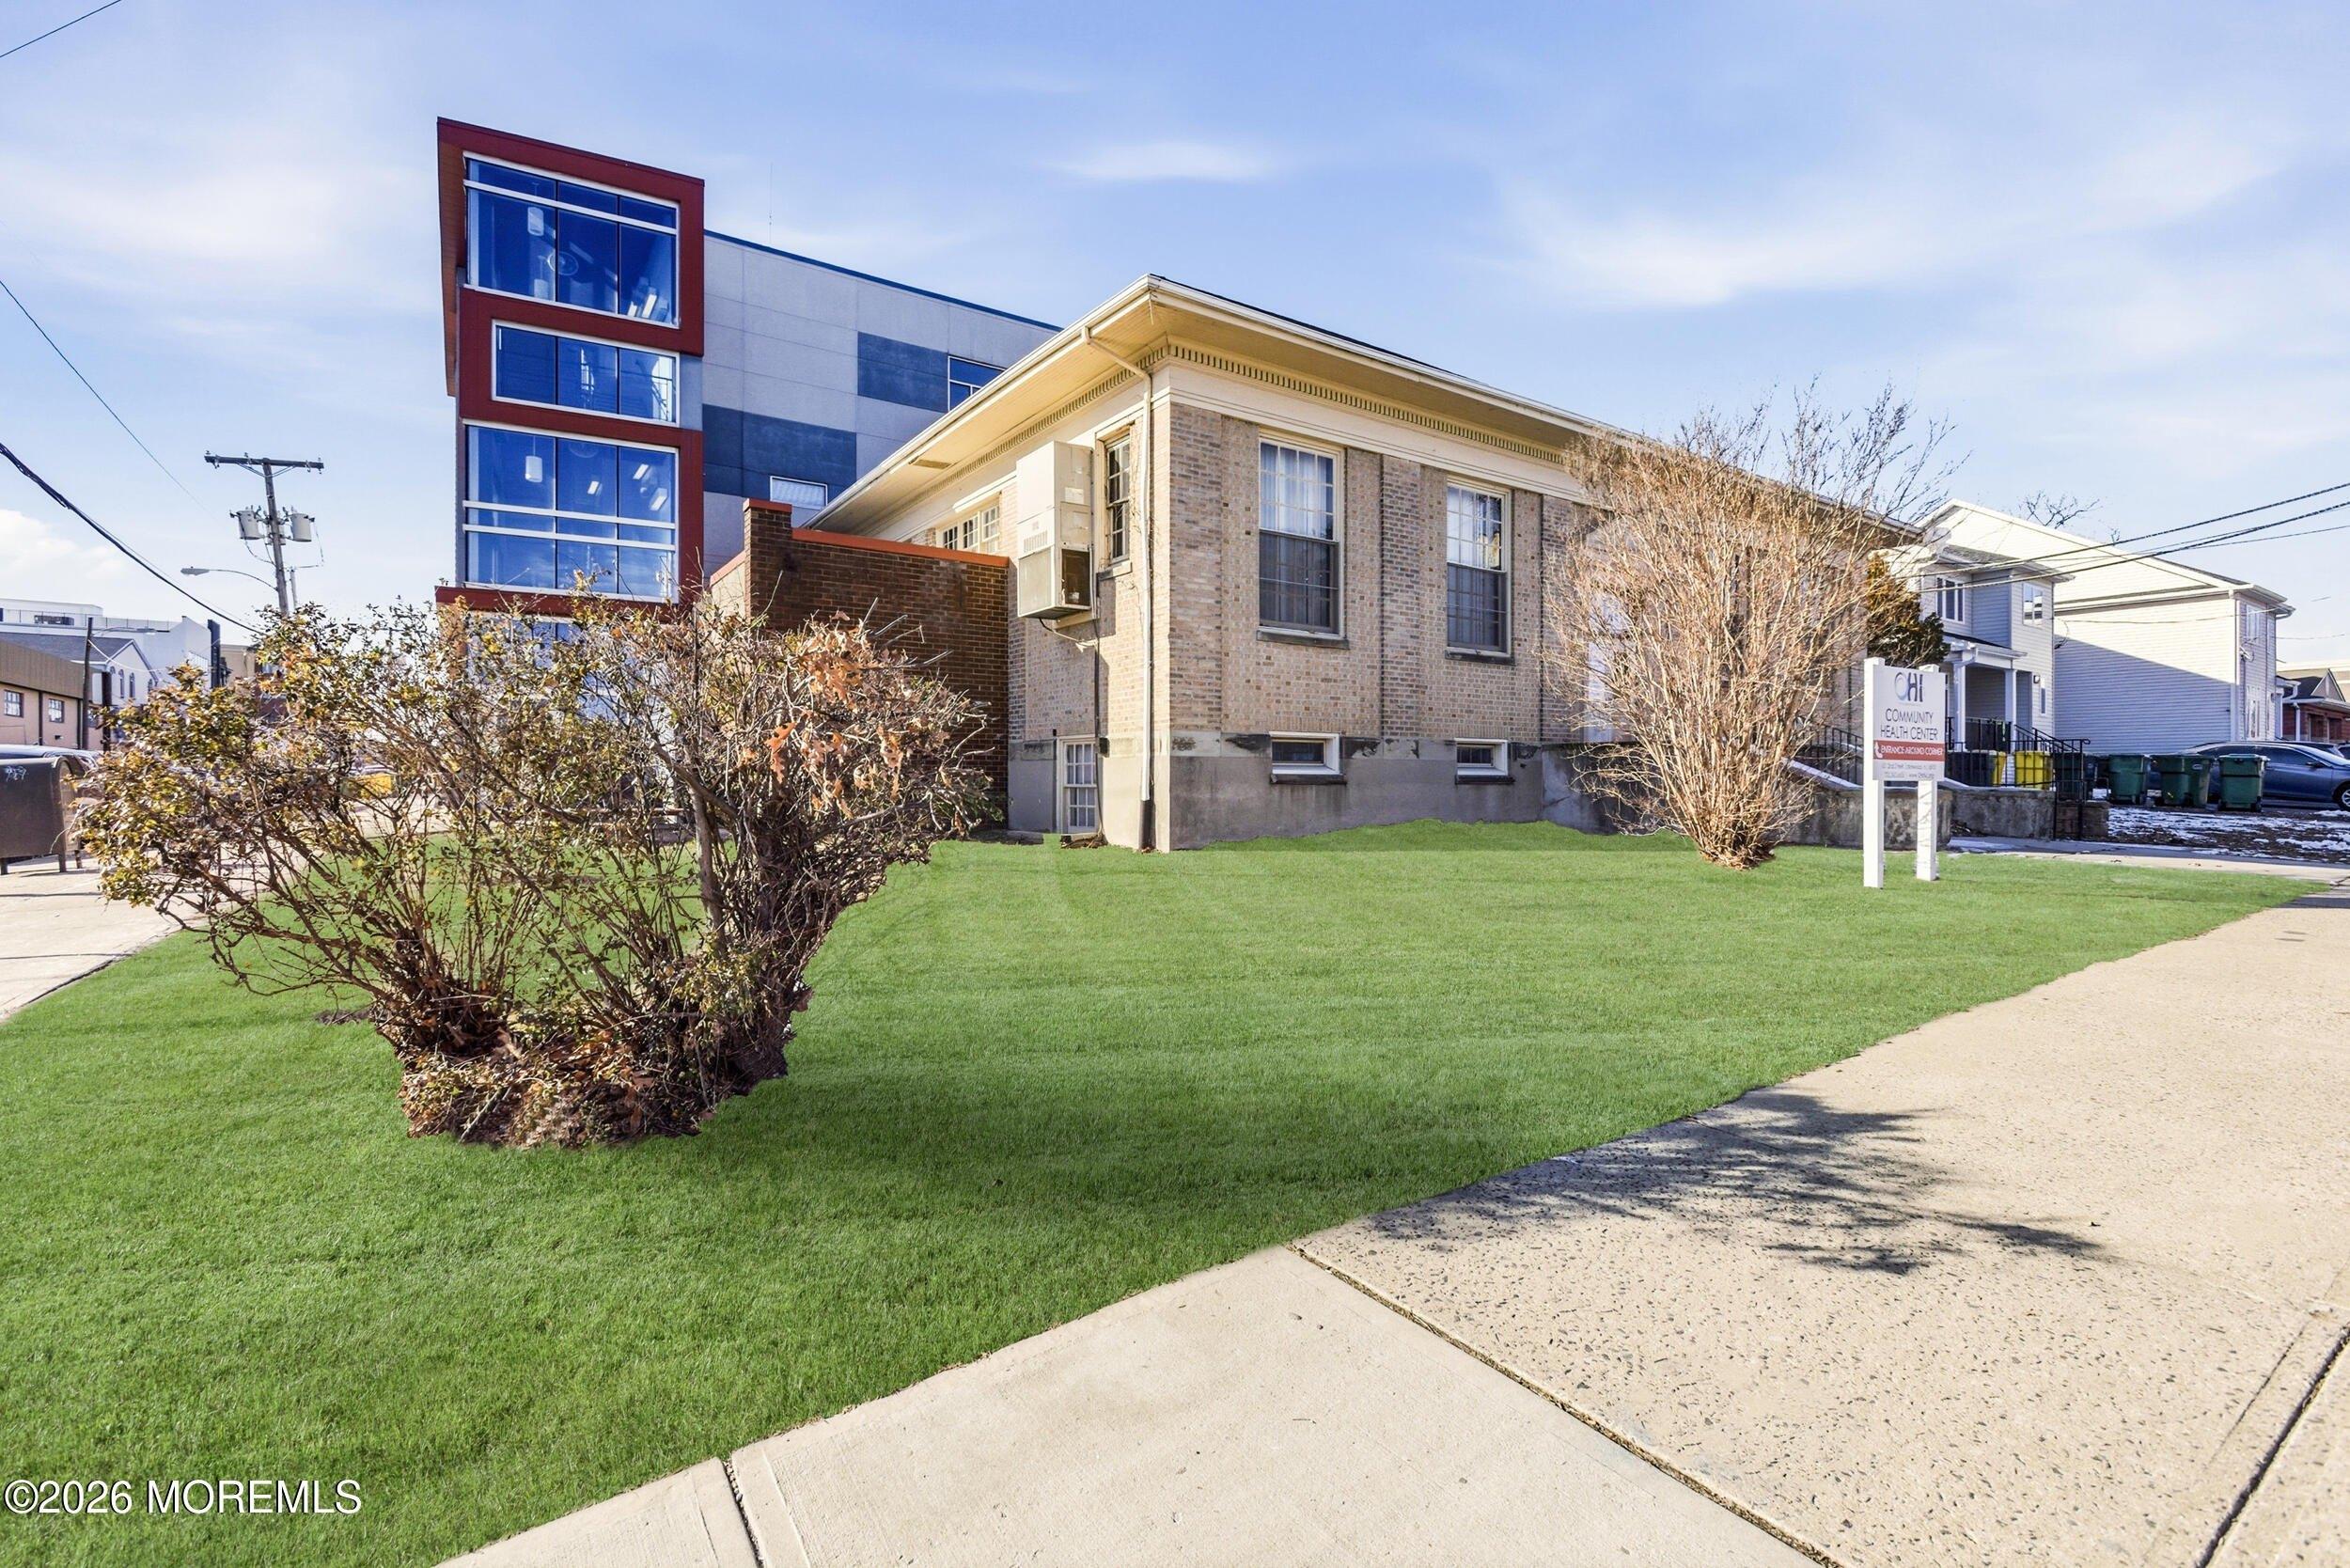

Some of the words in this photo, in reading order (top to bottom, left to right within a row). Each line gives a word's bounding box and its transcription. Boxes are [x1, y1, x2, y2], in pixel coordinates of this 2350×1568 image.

[1886, 708, 1934, 724] COMMUNITY
[1880, 725, 1908, 739] HEALTH
[1911, 727, 1938, 741] CENTER
